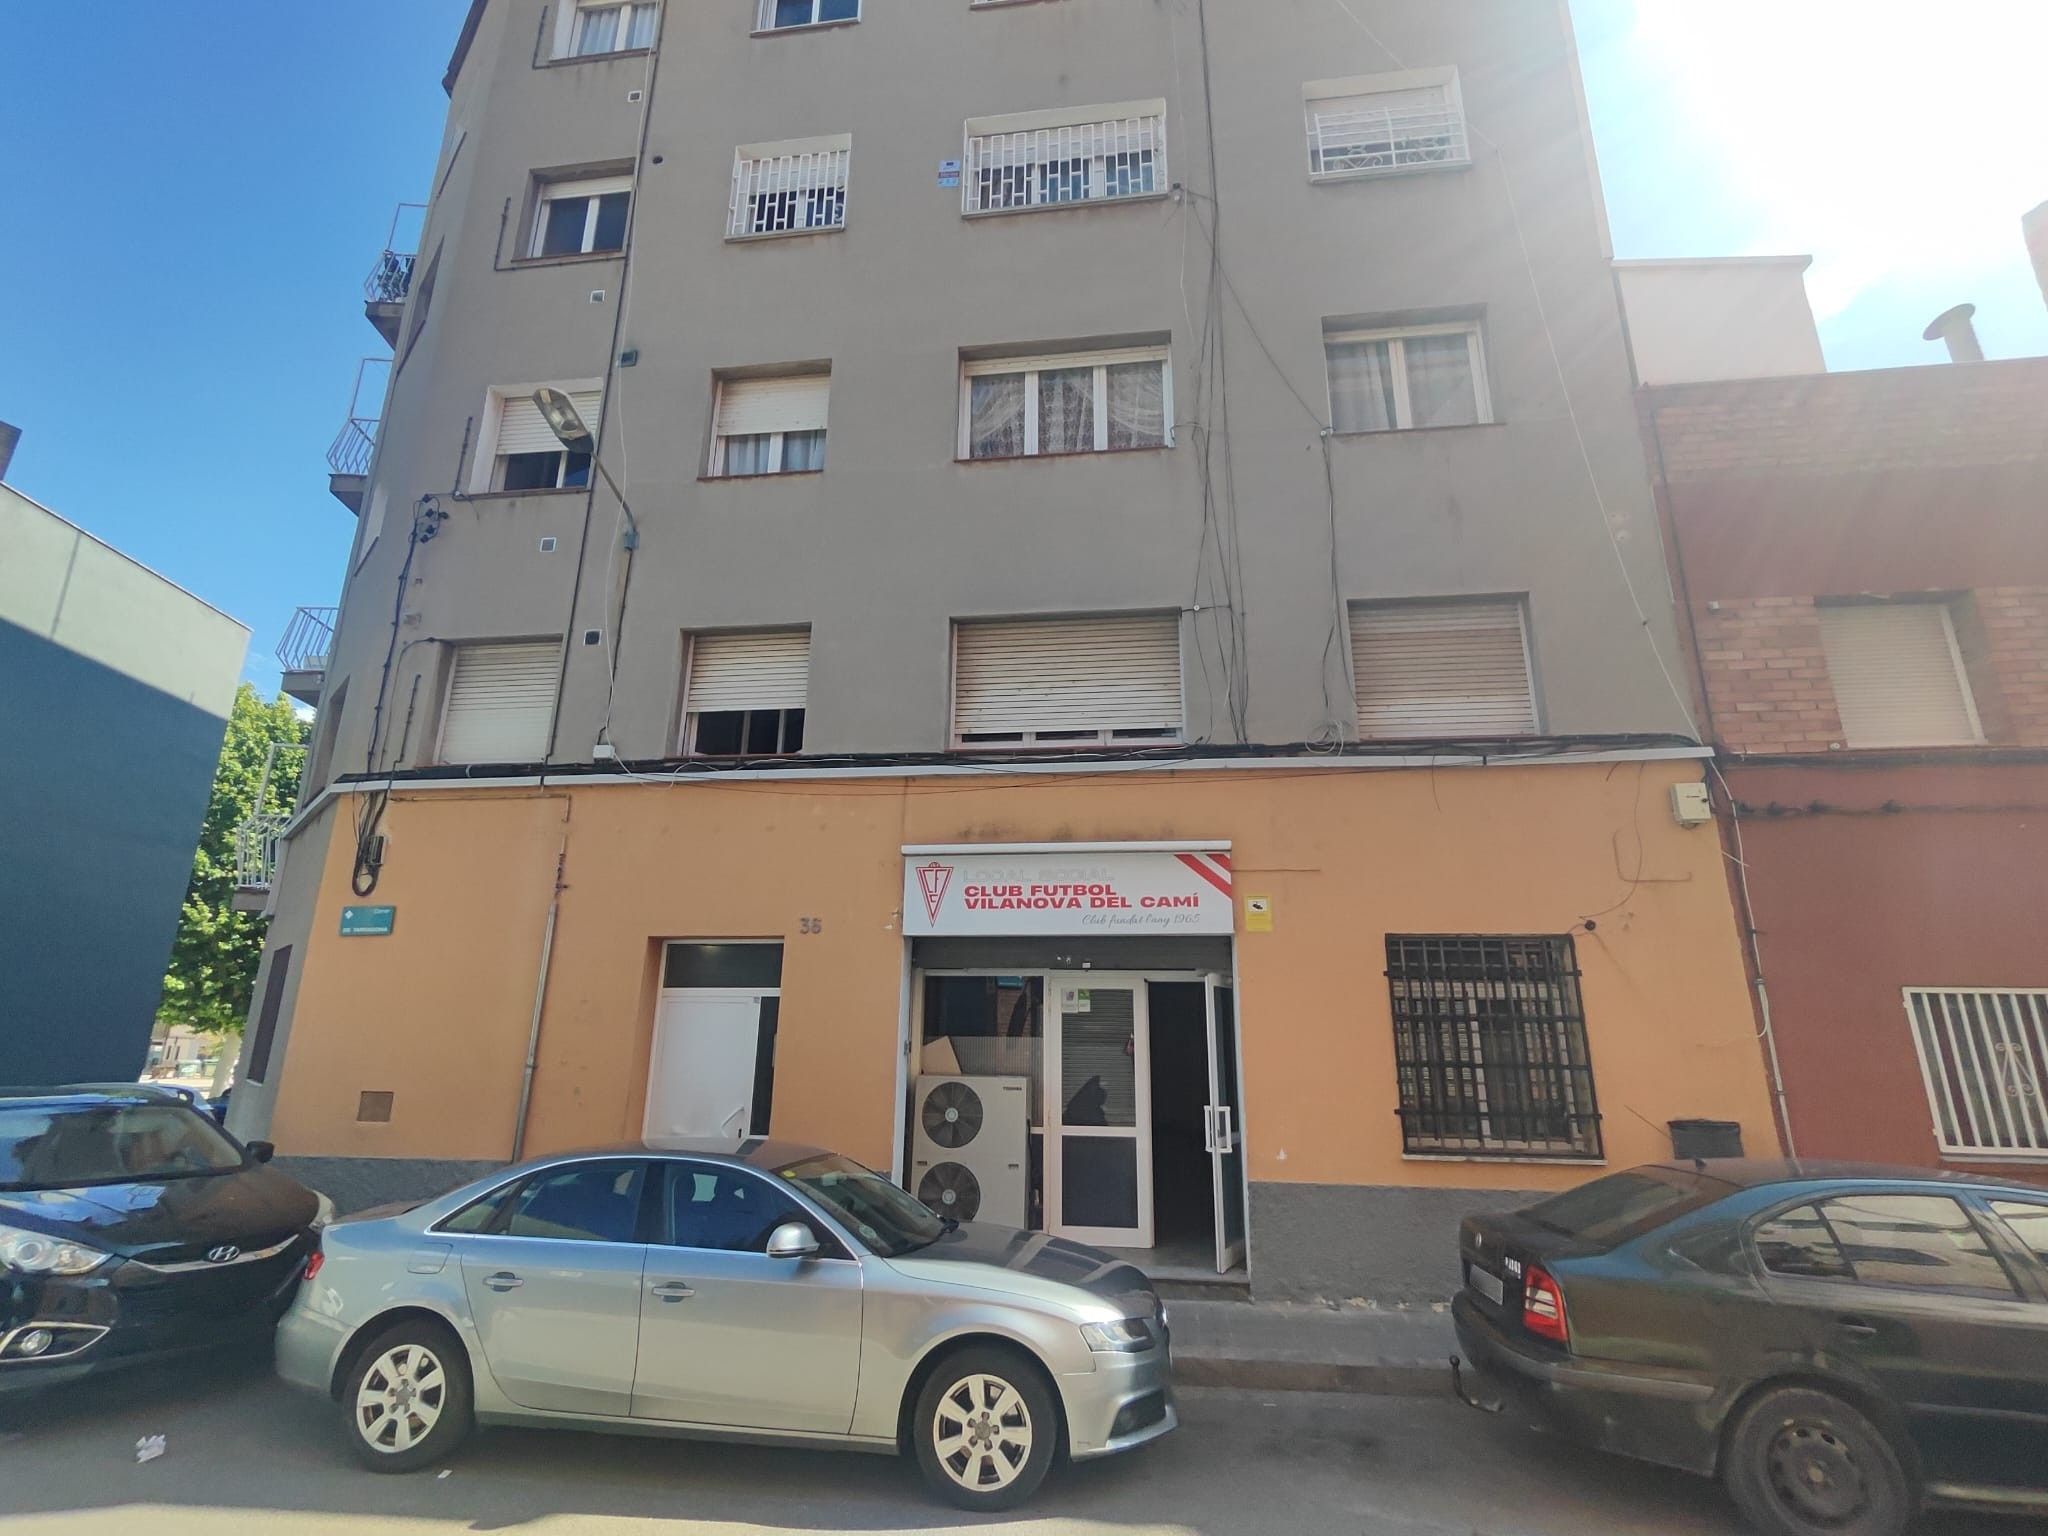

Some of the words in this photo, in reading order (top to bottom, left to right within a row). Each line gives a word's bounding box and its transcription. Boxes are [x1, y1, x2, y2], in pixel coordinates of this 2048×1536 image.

[964, 885, 1023, 897] CLUB
[1030, 884, 1117, 897] FUTBOL
[964, 897, 1082, 909] VILANOVA
[1090, 897, 1132, 908] DEL
[1140, 892, 1199, 908] CAMÍ
[800, 918, 822, 934] 36
[1082, 914, 1106, 925] Club
[1108, 913, 1143, 928] fundat
[1174, 914, 1201, 924] 1965
